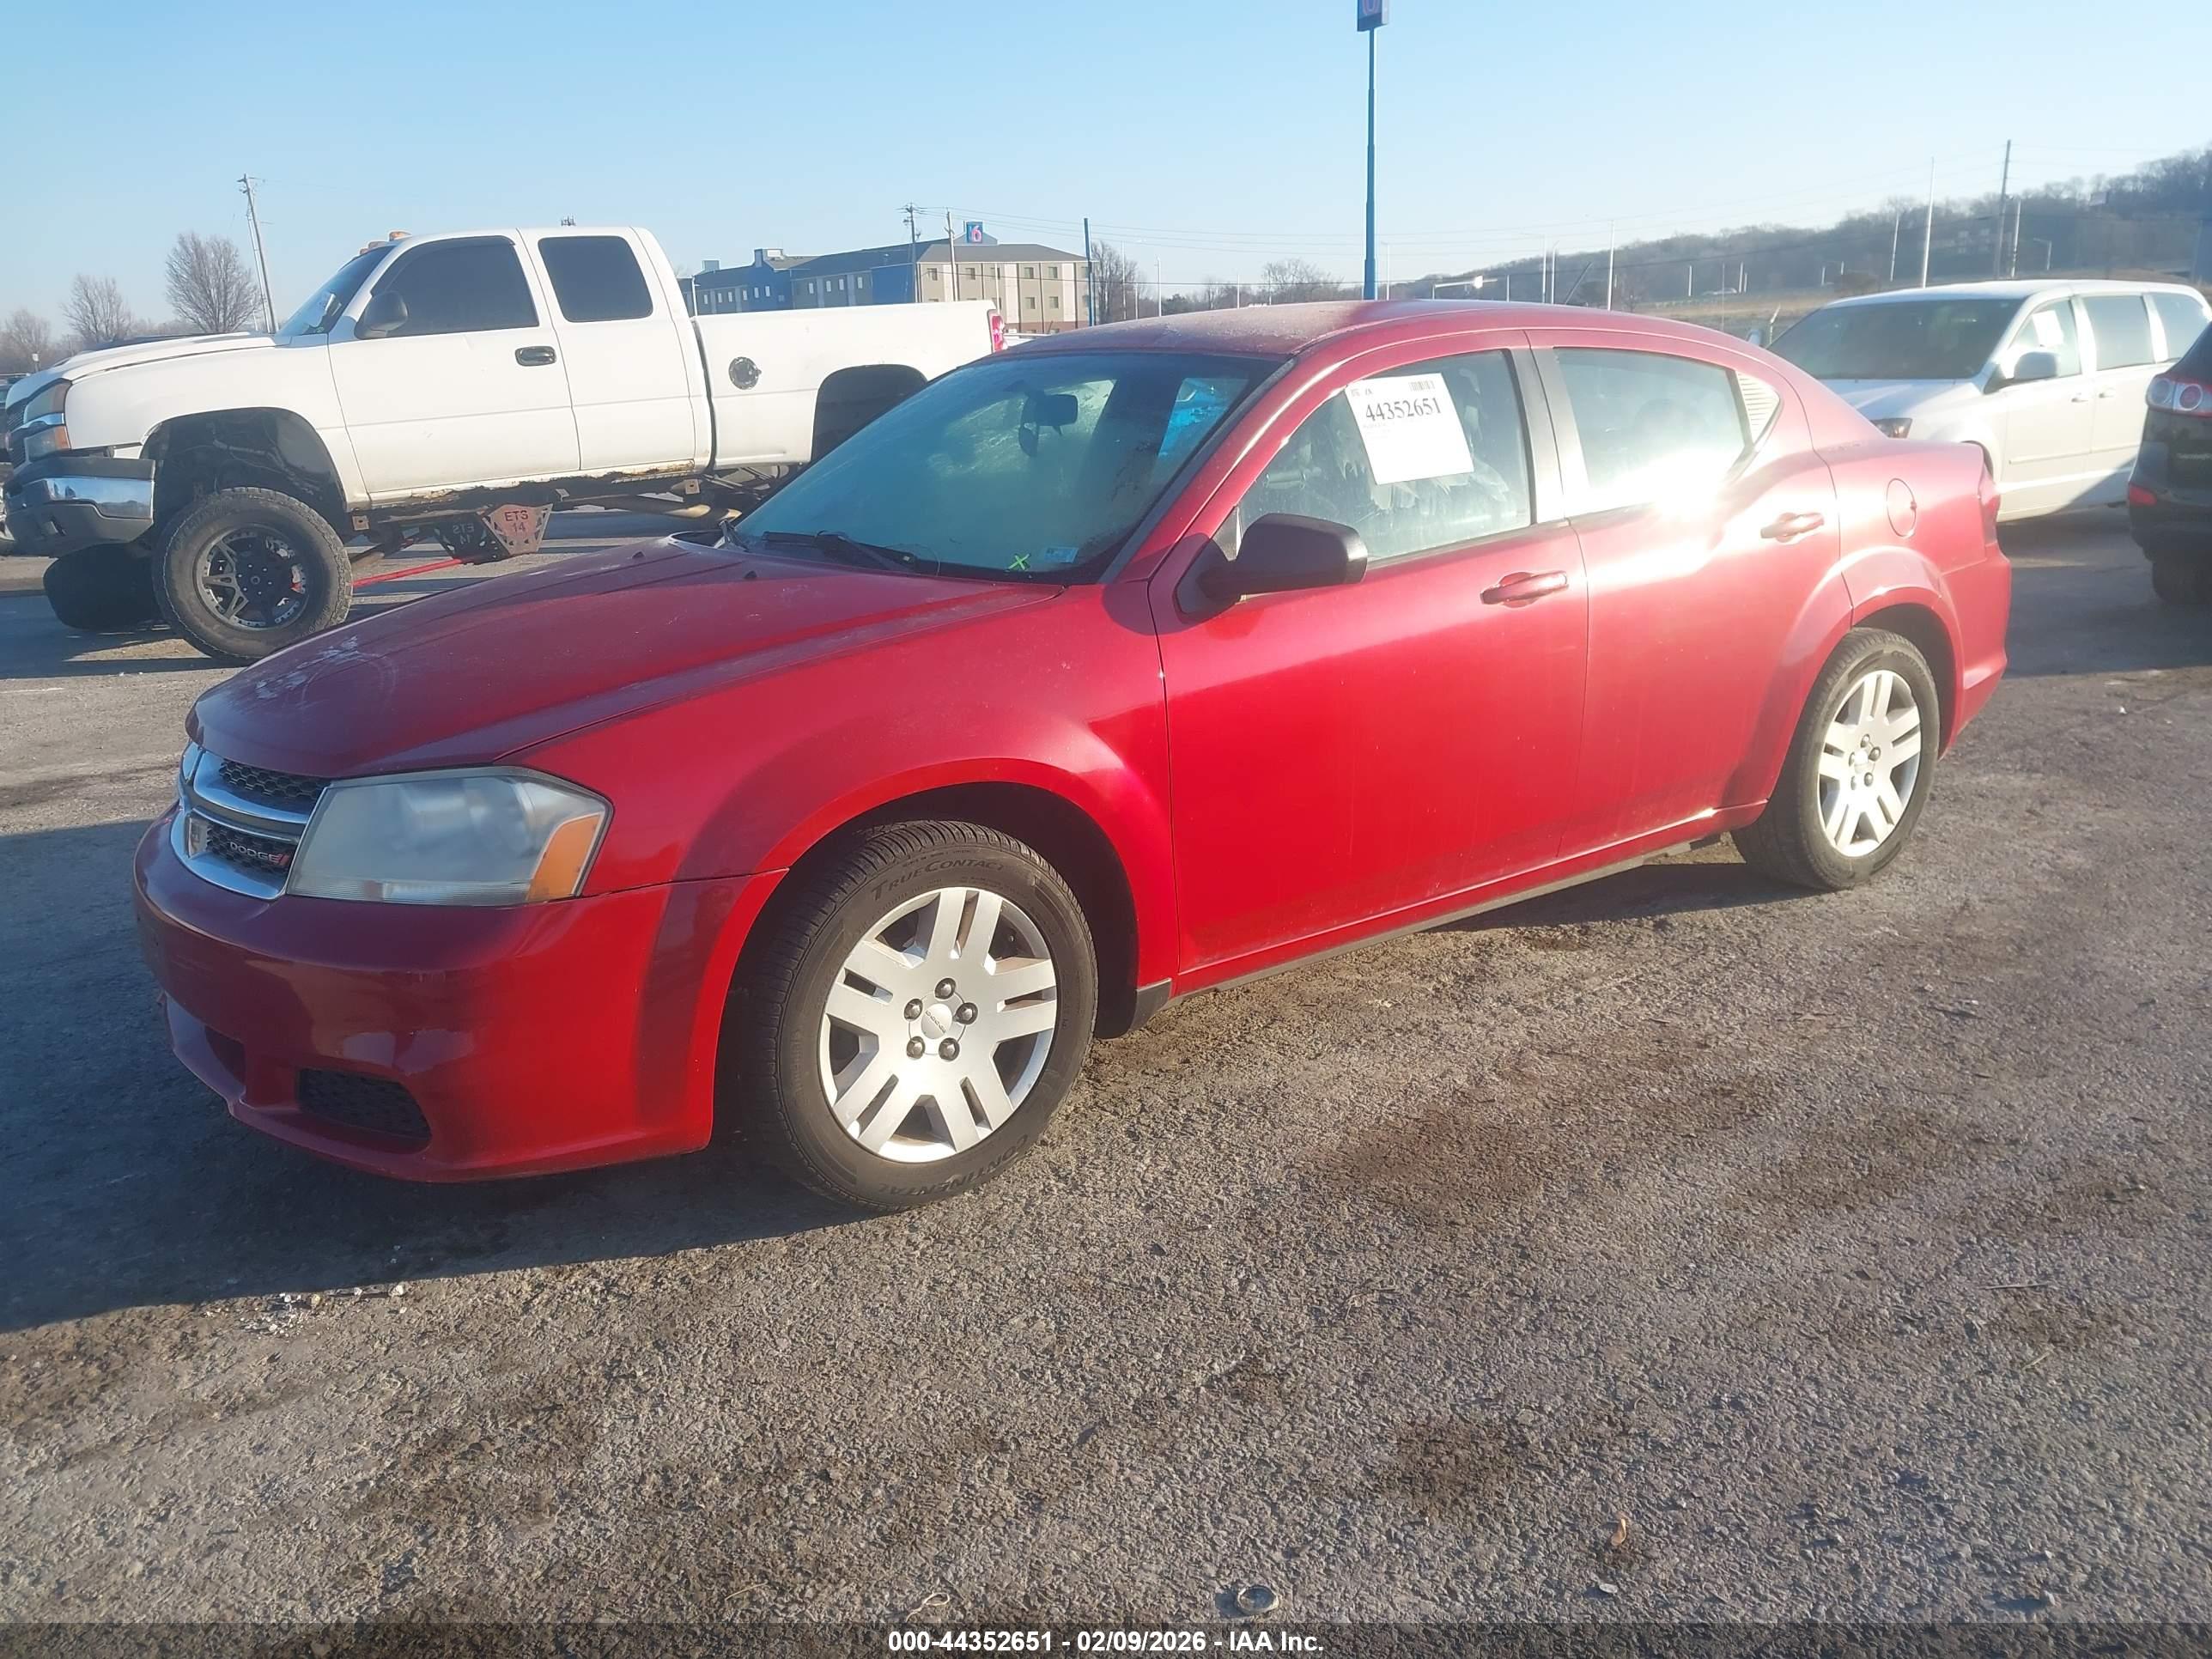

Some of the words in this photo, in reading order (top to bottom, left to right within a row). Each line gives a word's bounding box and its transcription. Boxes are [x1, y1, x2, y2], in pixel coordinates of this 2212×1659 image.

[971, 225, 982, 242] 6
[1365, 396, 1442, 422] 44352651
[504, 509, 529, 521] ETS
[513, 521, 526, 533] 14
[230, 842, 280, 863] DODGE
